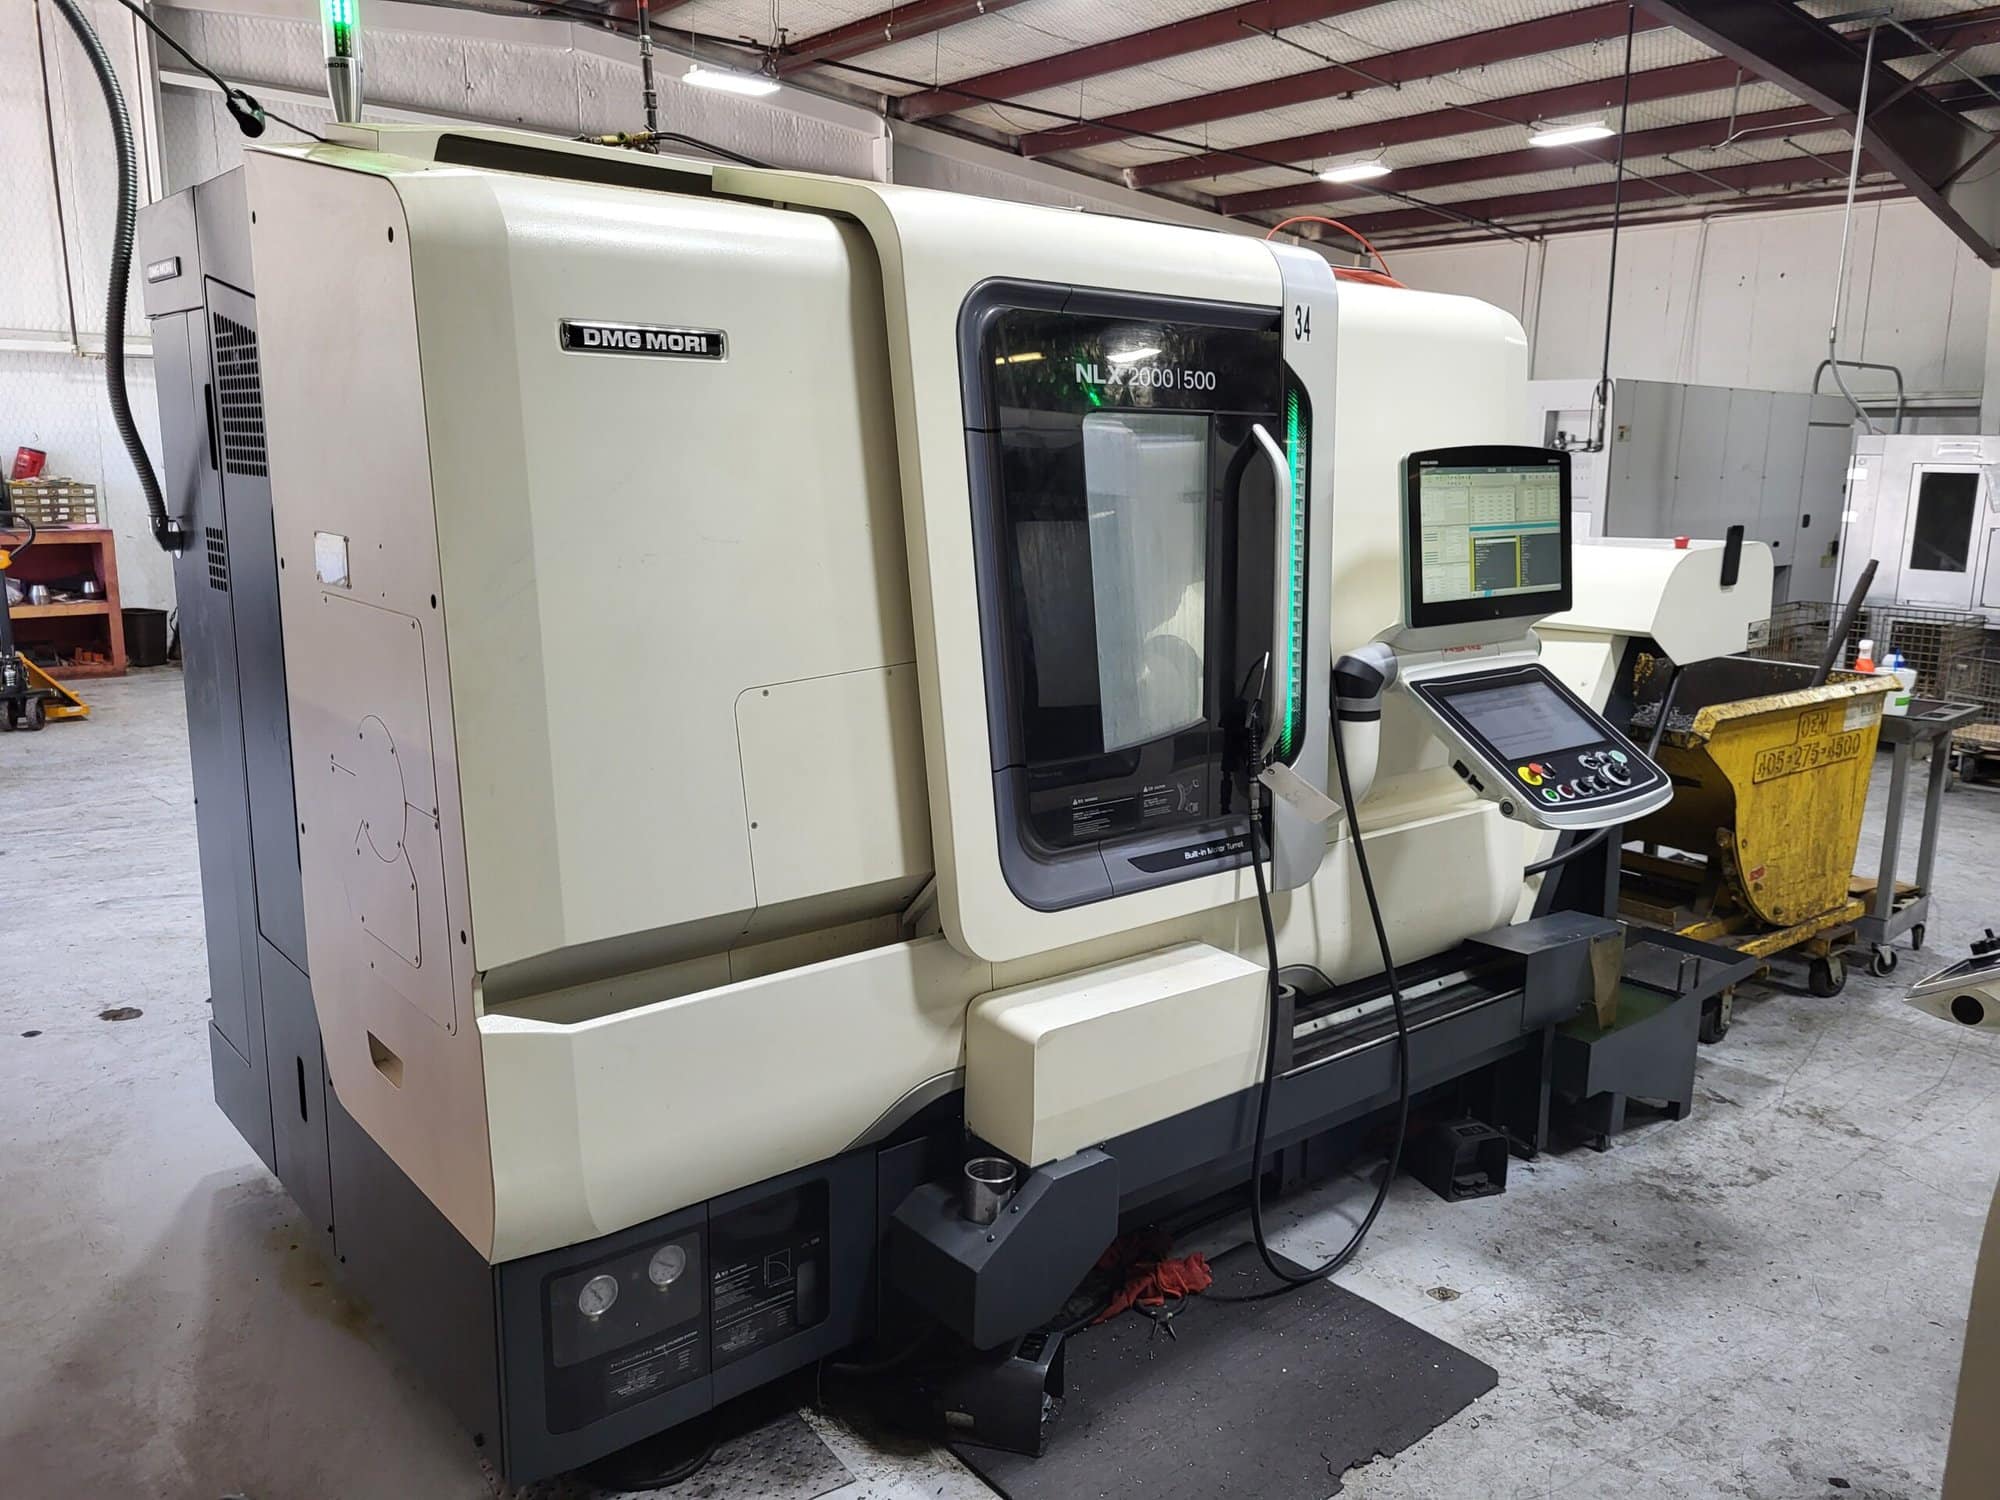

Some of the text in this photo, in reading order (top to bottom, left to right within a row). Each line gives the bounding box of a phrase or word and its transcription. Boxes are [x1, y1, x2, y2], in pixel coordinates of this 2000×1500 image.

[1295, 304, 1311, 342] 34
[583, 328, 707, 352] DMG MORI
[1075, 363, 1122, 385] NLX
[1800, 711, 1829, 738] OEM
